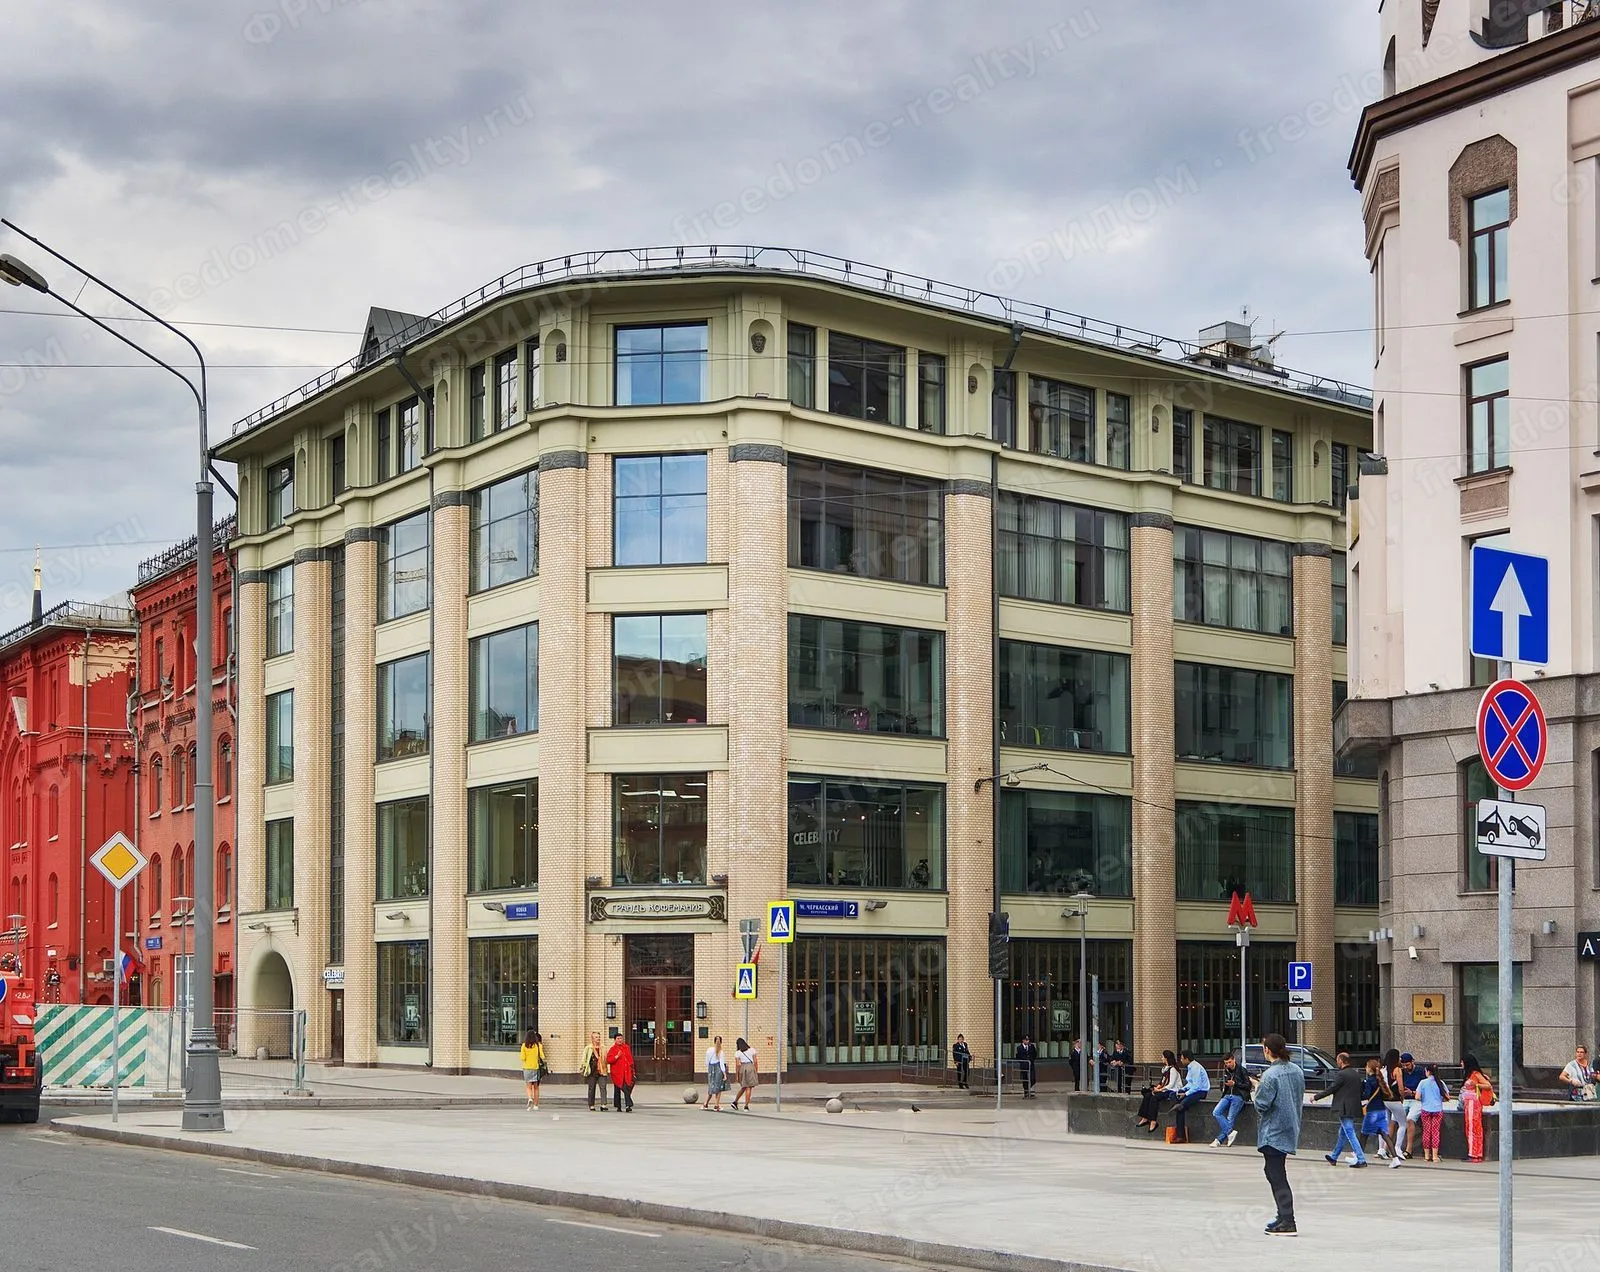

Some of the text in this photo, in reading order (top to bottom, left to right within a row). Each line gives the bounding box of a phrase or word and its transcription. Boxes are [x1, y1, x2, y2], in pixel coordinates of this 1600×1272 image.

[611, 903, 704, 914] ГРАНДЪ КОФЕМАНИЯ
[849, 904, 856, 915] 2
[1294, 966, 1307, 987] P
